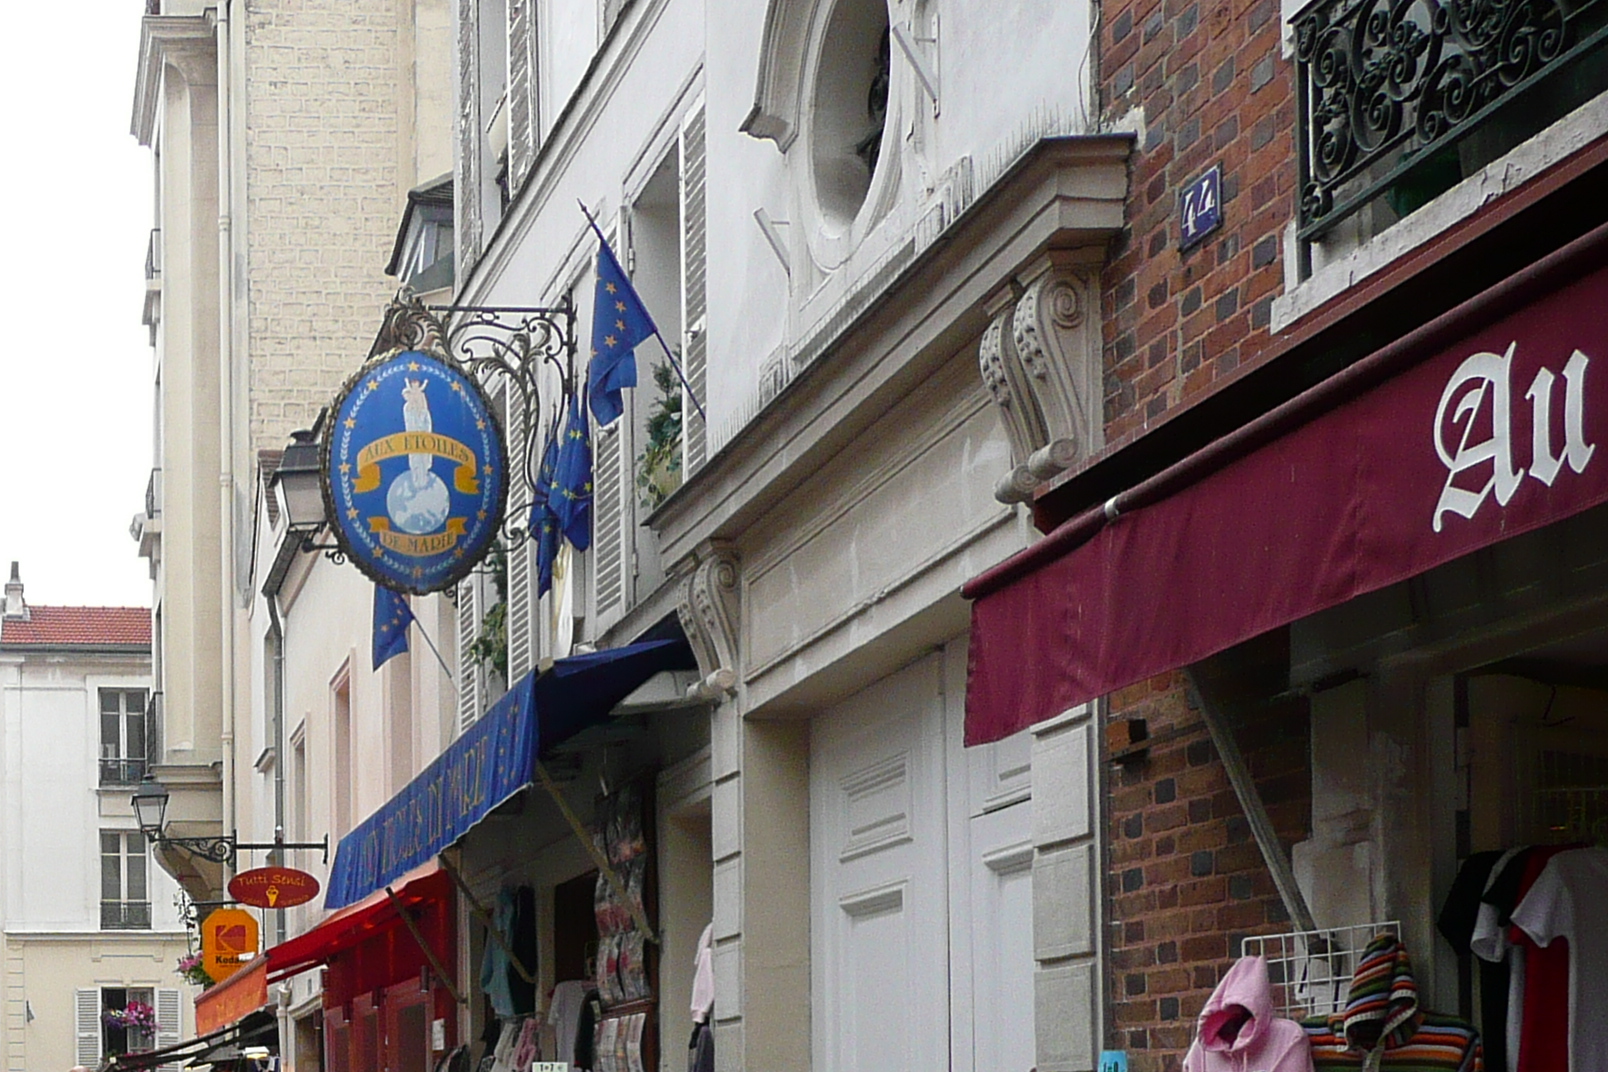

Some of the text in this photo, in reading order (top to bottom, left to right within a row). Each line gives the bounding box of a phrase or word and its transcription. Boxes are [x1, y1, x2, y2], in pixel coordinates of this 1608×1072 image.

[1181, 177, 1217, 239] 44
[365, 443, 396, 462] AUX
[1431, 340, 1596, 532] Au
[237, 874, 306, 887] Tutti Sensi
